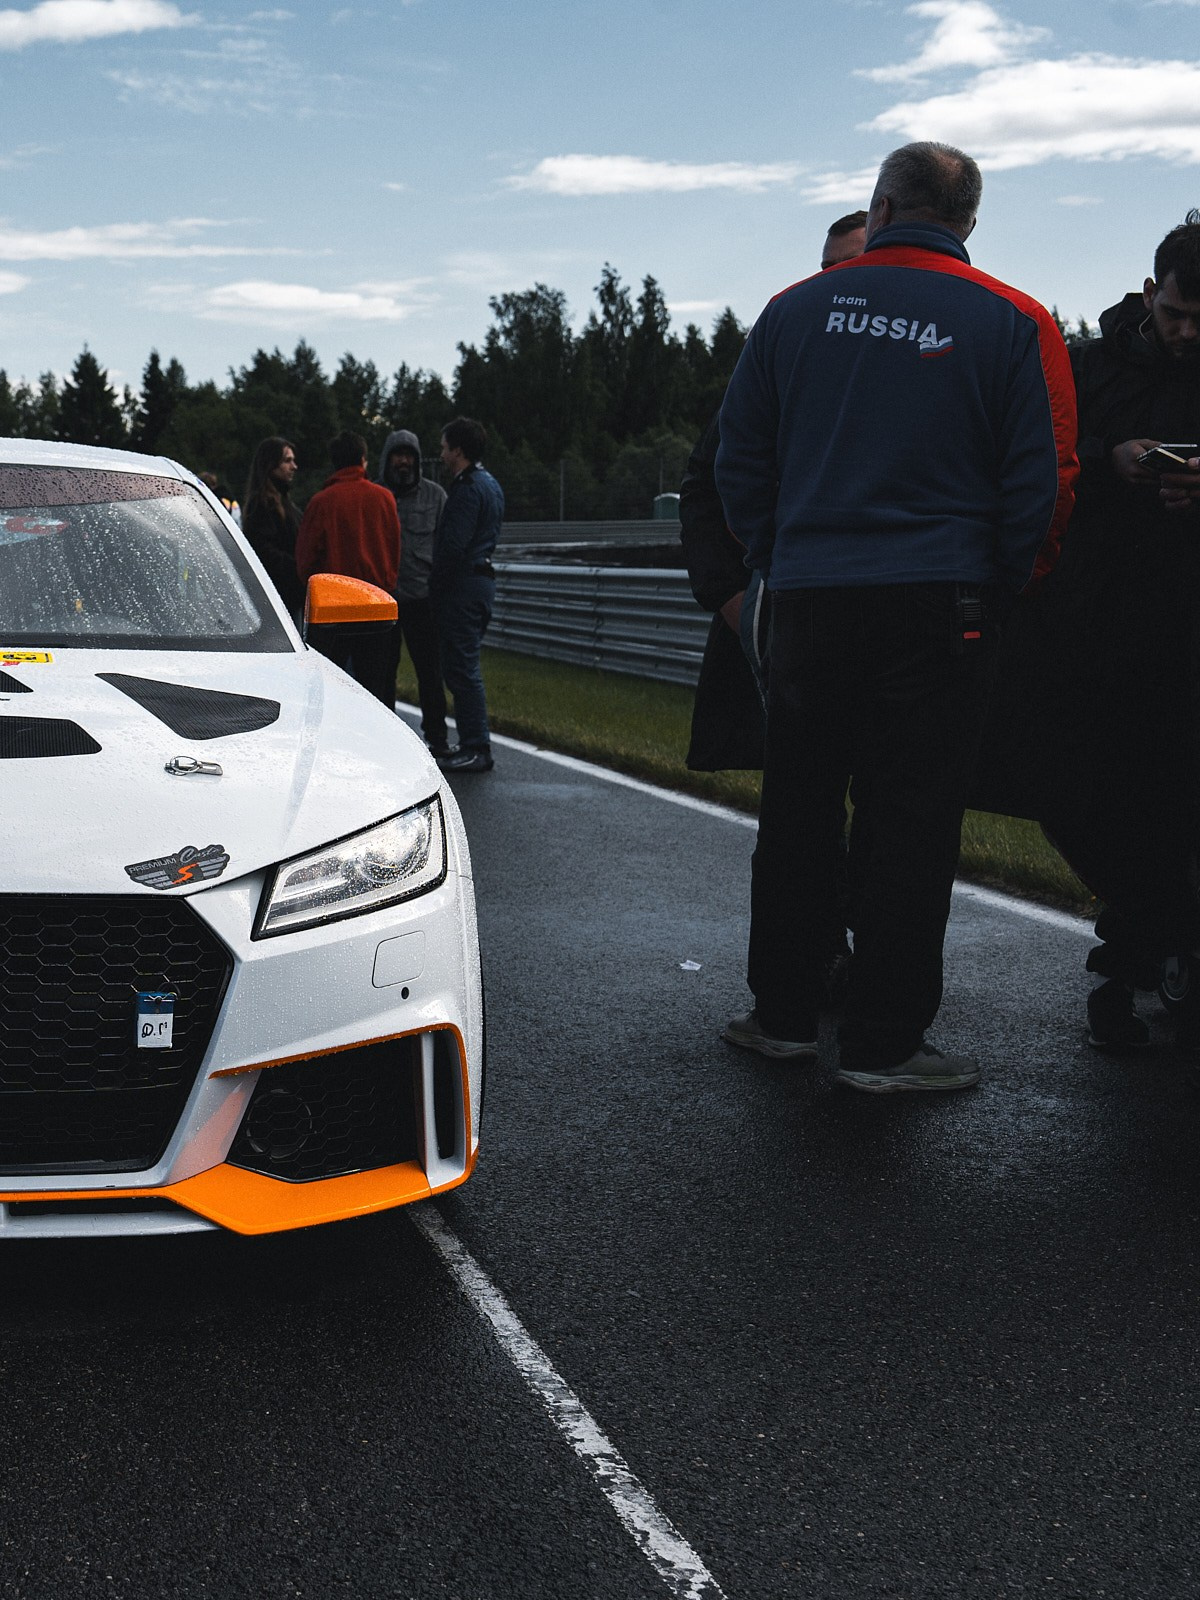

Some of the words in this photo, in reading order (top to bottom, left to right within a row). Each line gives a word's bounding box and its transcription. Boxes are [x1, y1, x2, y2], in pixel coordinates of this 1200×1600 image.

[832, 294, 867, 306] team
[825, 311, 938, 345] RUSSIA
[128, 857, 177, 874] PREMIUM
